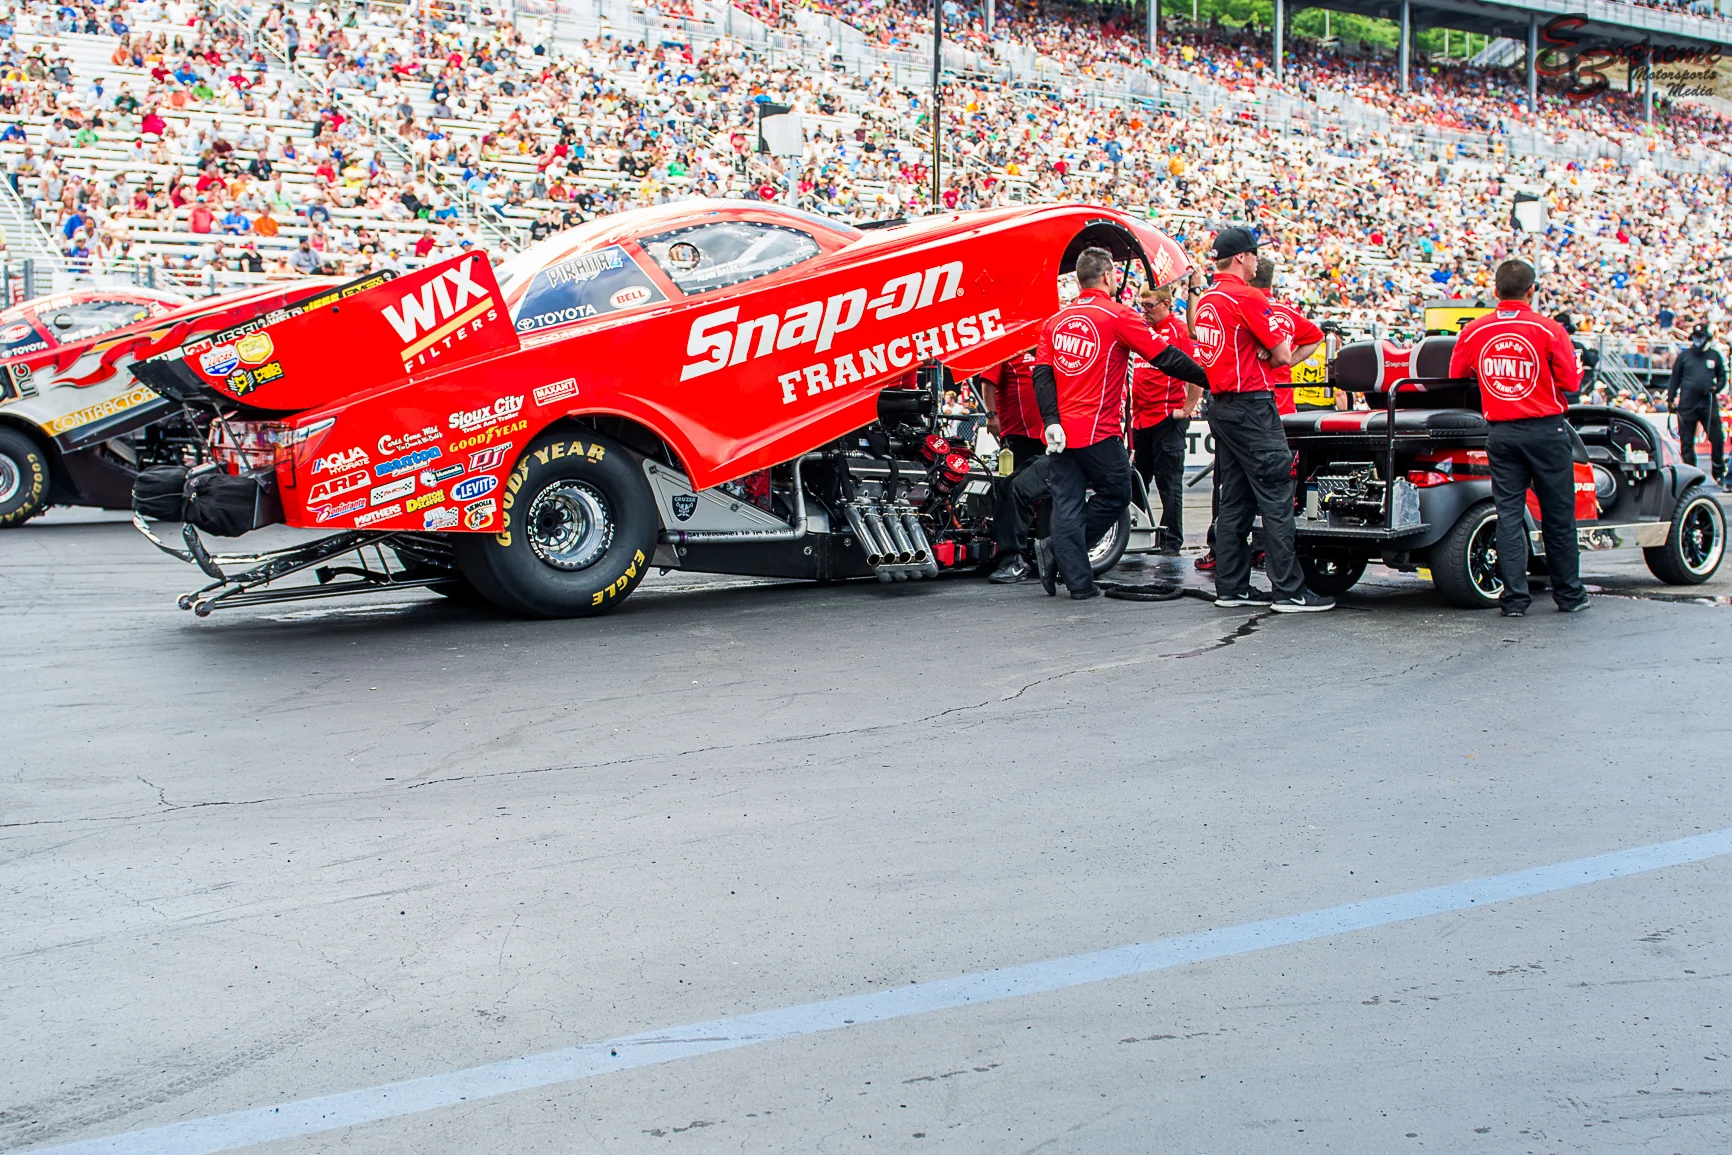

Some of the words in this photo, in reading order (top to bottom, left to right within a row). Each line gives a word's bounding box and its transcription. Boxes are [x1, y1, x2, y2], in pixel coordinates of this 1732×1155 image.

[382, 256, 489, 343] WIX
[616, 290, 646, 304] BELL
[535, 304, 597, 327] TOYOTA
[680, 260, 964, 382] Snap-on
[13, 341, 49, 355] TOYOTA
[404, 309, 498, 373] FILTERS
[1054, 333, 1080, 354] OWN
[1080, 340, 1095, 358] IT
[1209, 328, 1221, 347] IT
[1495, 341, 1523, 354] SNAP-ON
[778, 308, 1006, 405] FRANCHISE
[1484, 358, 1517, 377] OWN
[1517, 361, 1534, 379] IT
[536, 380, 574, 398] MAXANT
[448, 406, 490, 429] Sioux
[494, 395, 524, 415] City
[462, 424, 482, 433] Truck
[314, 447, 368, 472] AQUA
[329, 457, 370, 475] HYDRATE
[375, 446, 442, 475] manton
[0, 452, 43, 523] GOODYEA
[310, 471, 368, 500] ARP
[529, 481, 561, 517] RACING
[354, 504, 402, 525] MOTHERS
[592, 549, 646, 606] EAGLE
